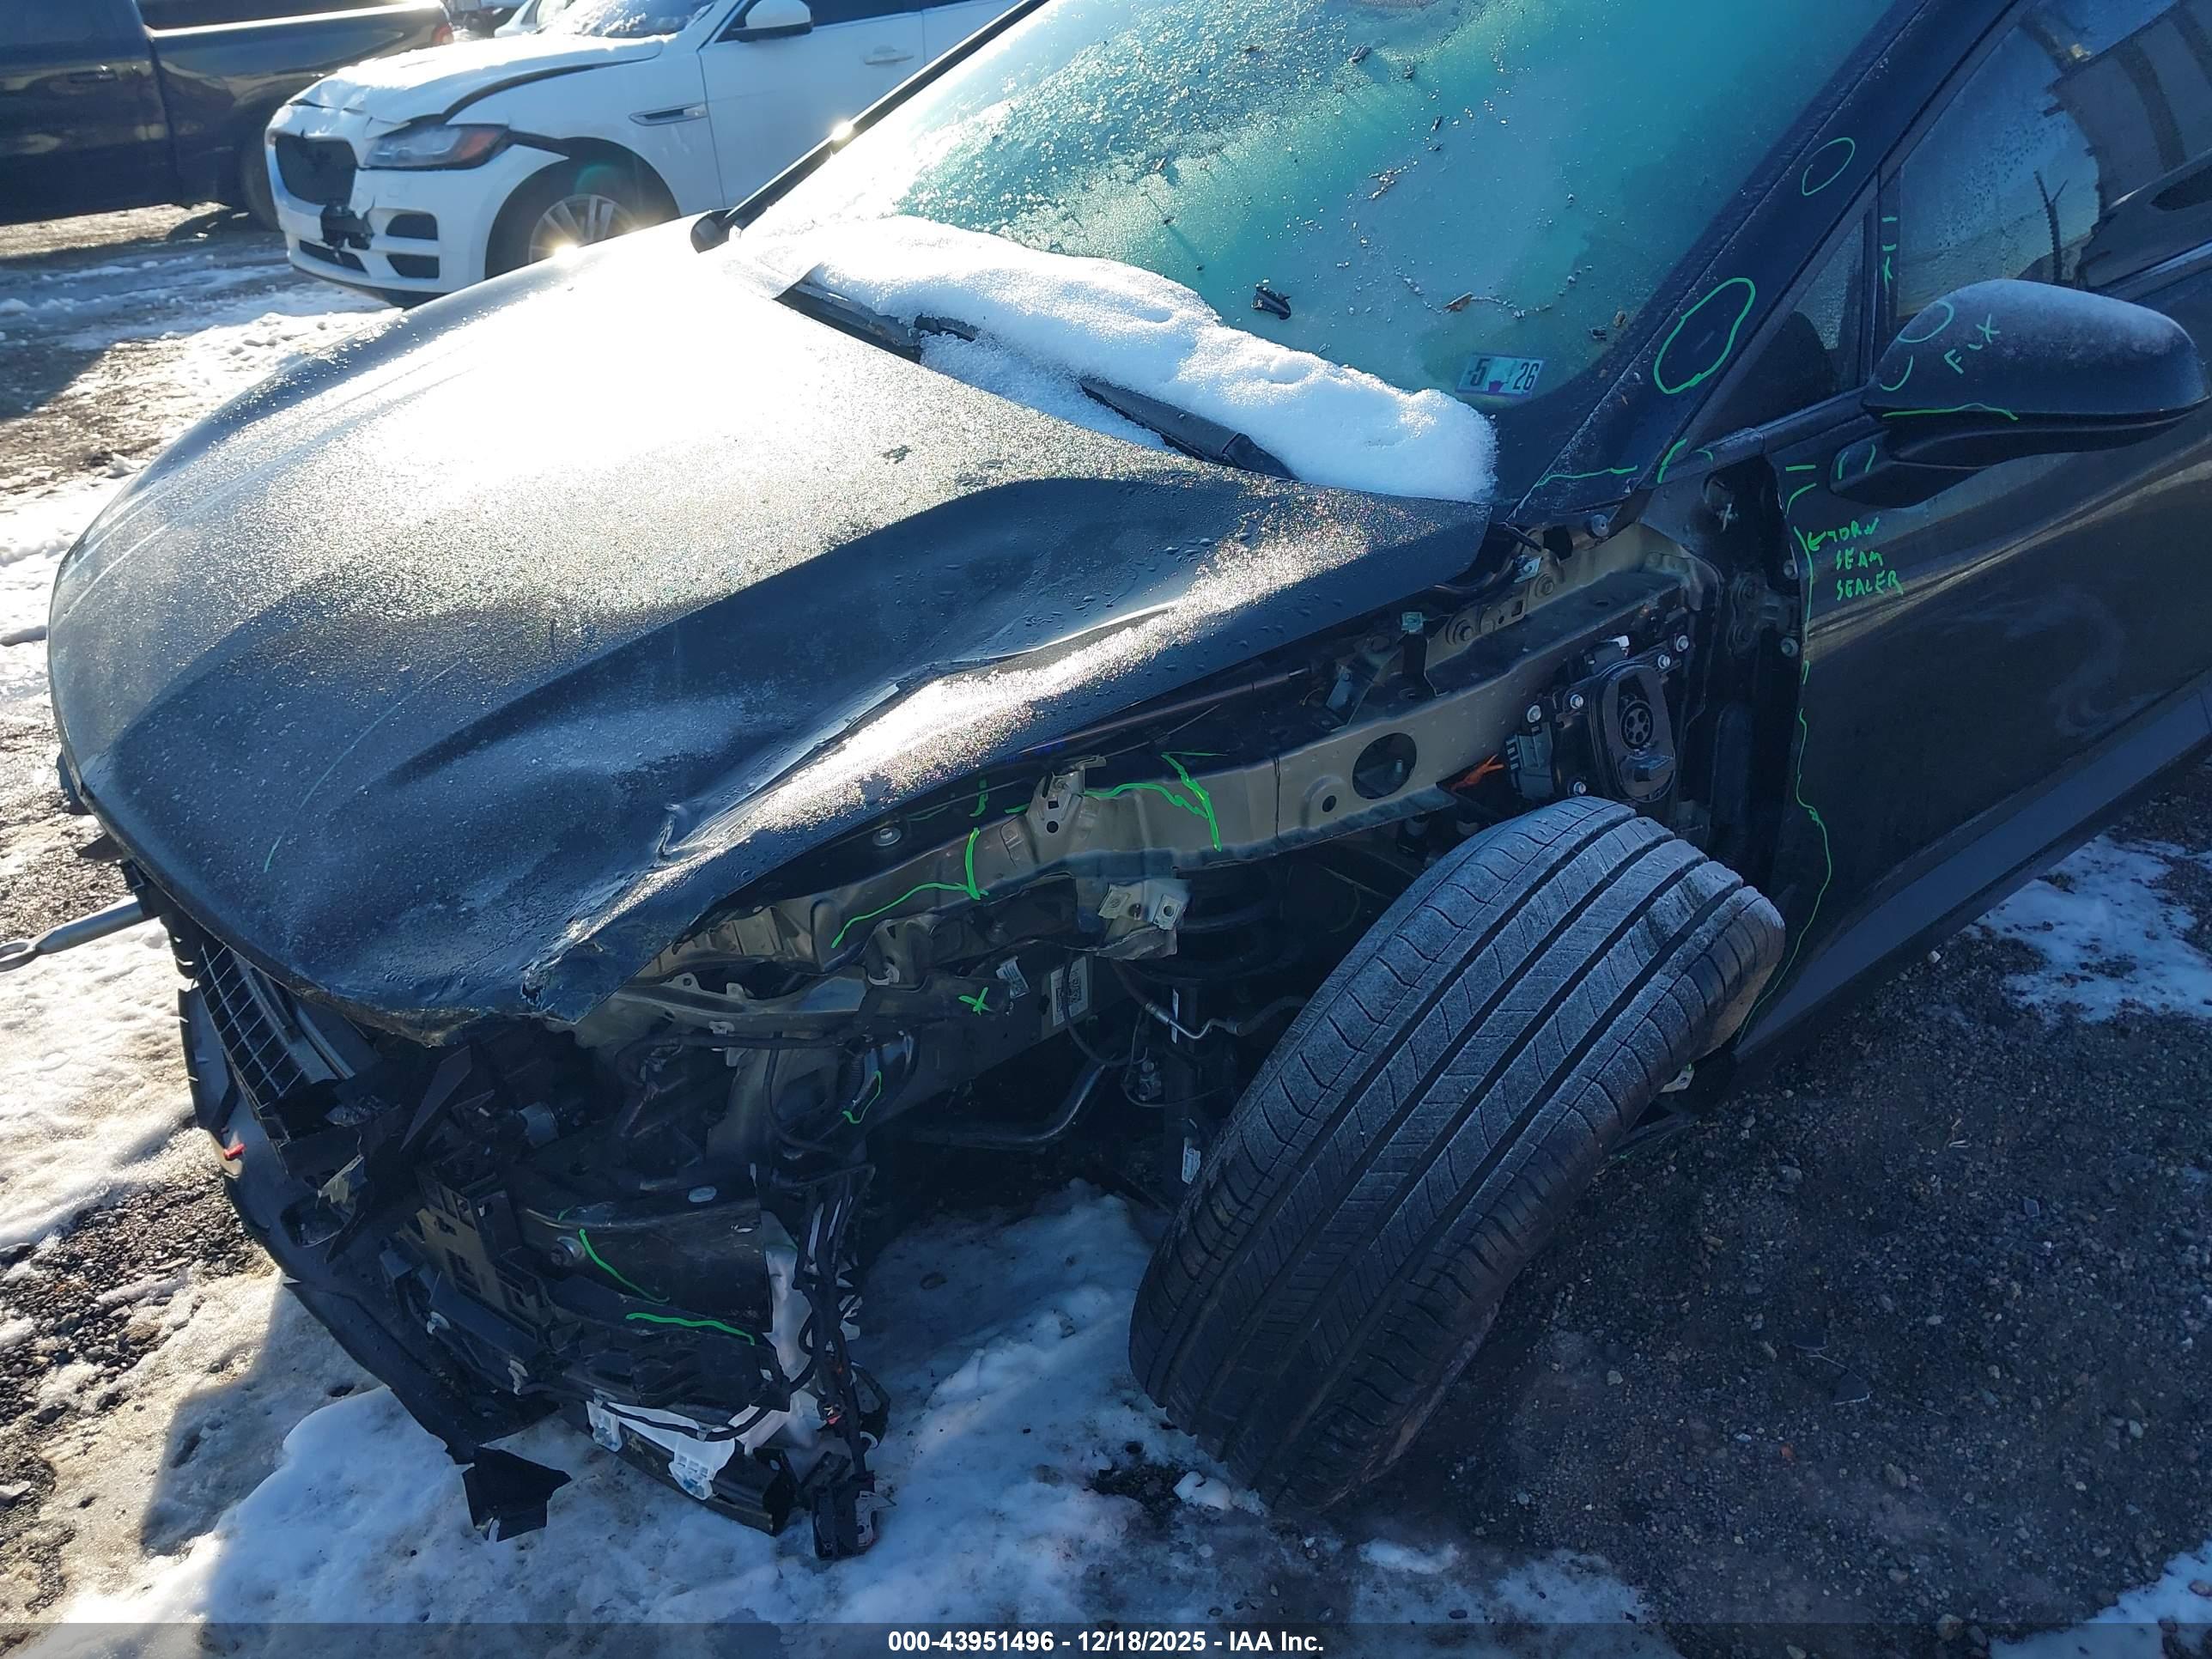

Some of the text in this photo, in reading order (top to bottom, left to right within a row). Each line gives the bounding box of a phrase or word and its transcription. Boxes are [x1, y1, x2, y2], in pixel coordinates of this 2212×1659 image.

[1468, 358, 1540, 391] 5 26
[1835, 547, 1884, 570] SEAM
[1835, 569, 1904, 600] SEALER
